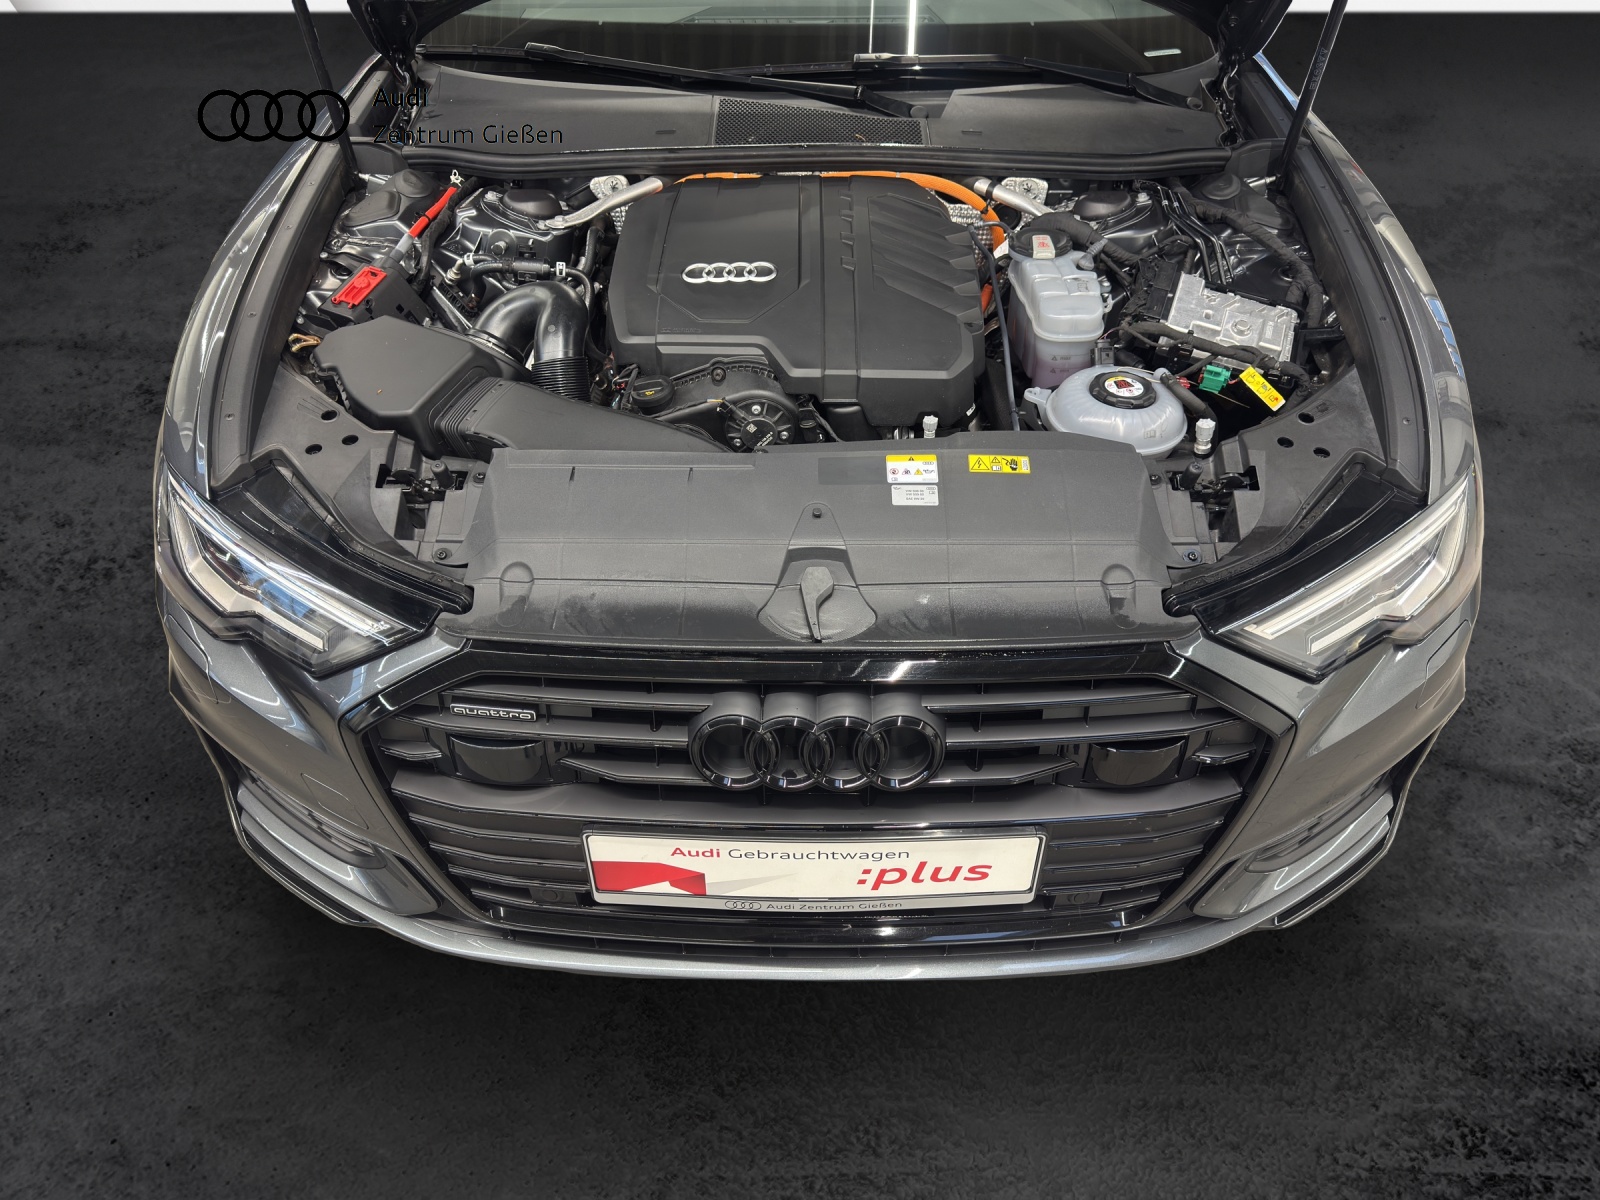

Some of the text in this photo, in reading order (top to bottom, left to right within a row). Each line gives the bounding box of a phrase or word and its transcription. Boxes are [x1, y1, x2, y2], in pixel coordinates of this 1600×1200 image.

[453, 707, 531, 719] quattro
[671, 847, 910, 862] Audi Gebrauchtwagen
[856, 861, 993, 891] :plus
[799, 903, 855, 911] Zentrum
[858, 902, 903, 910] Gießen
